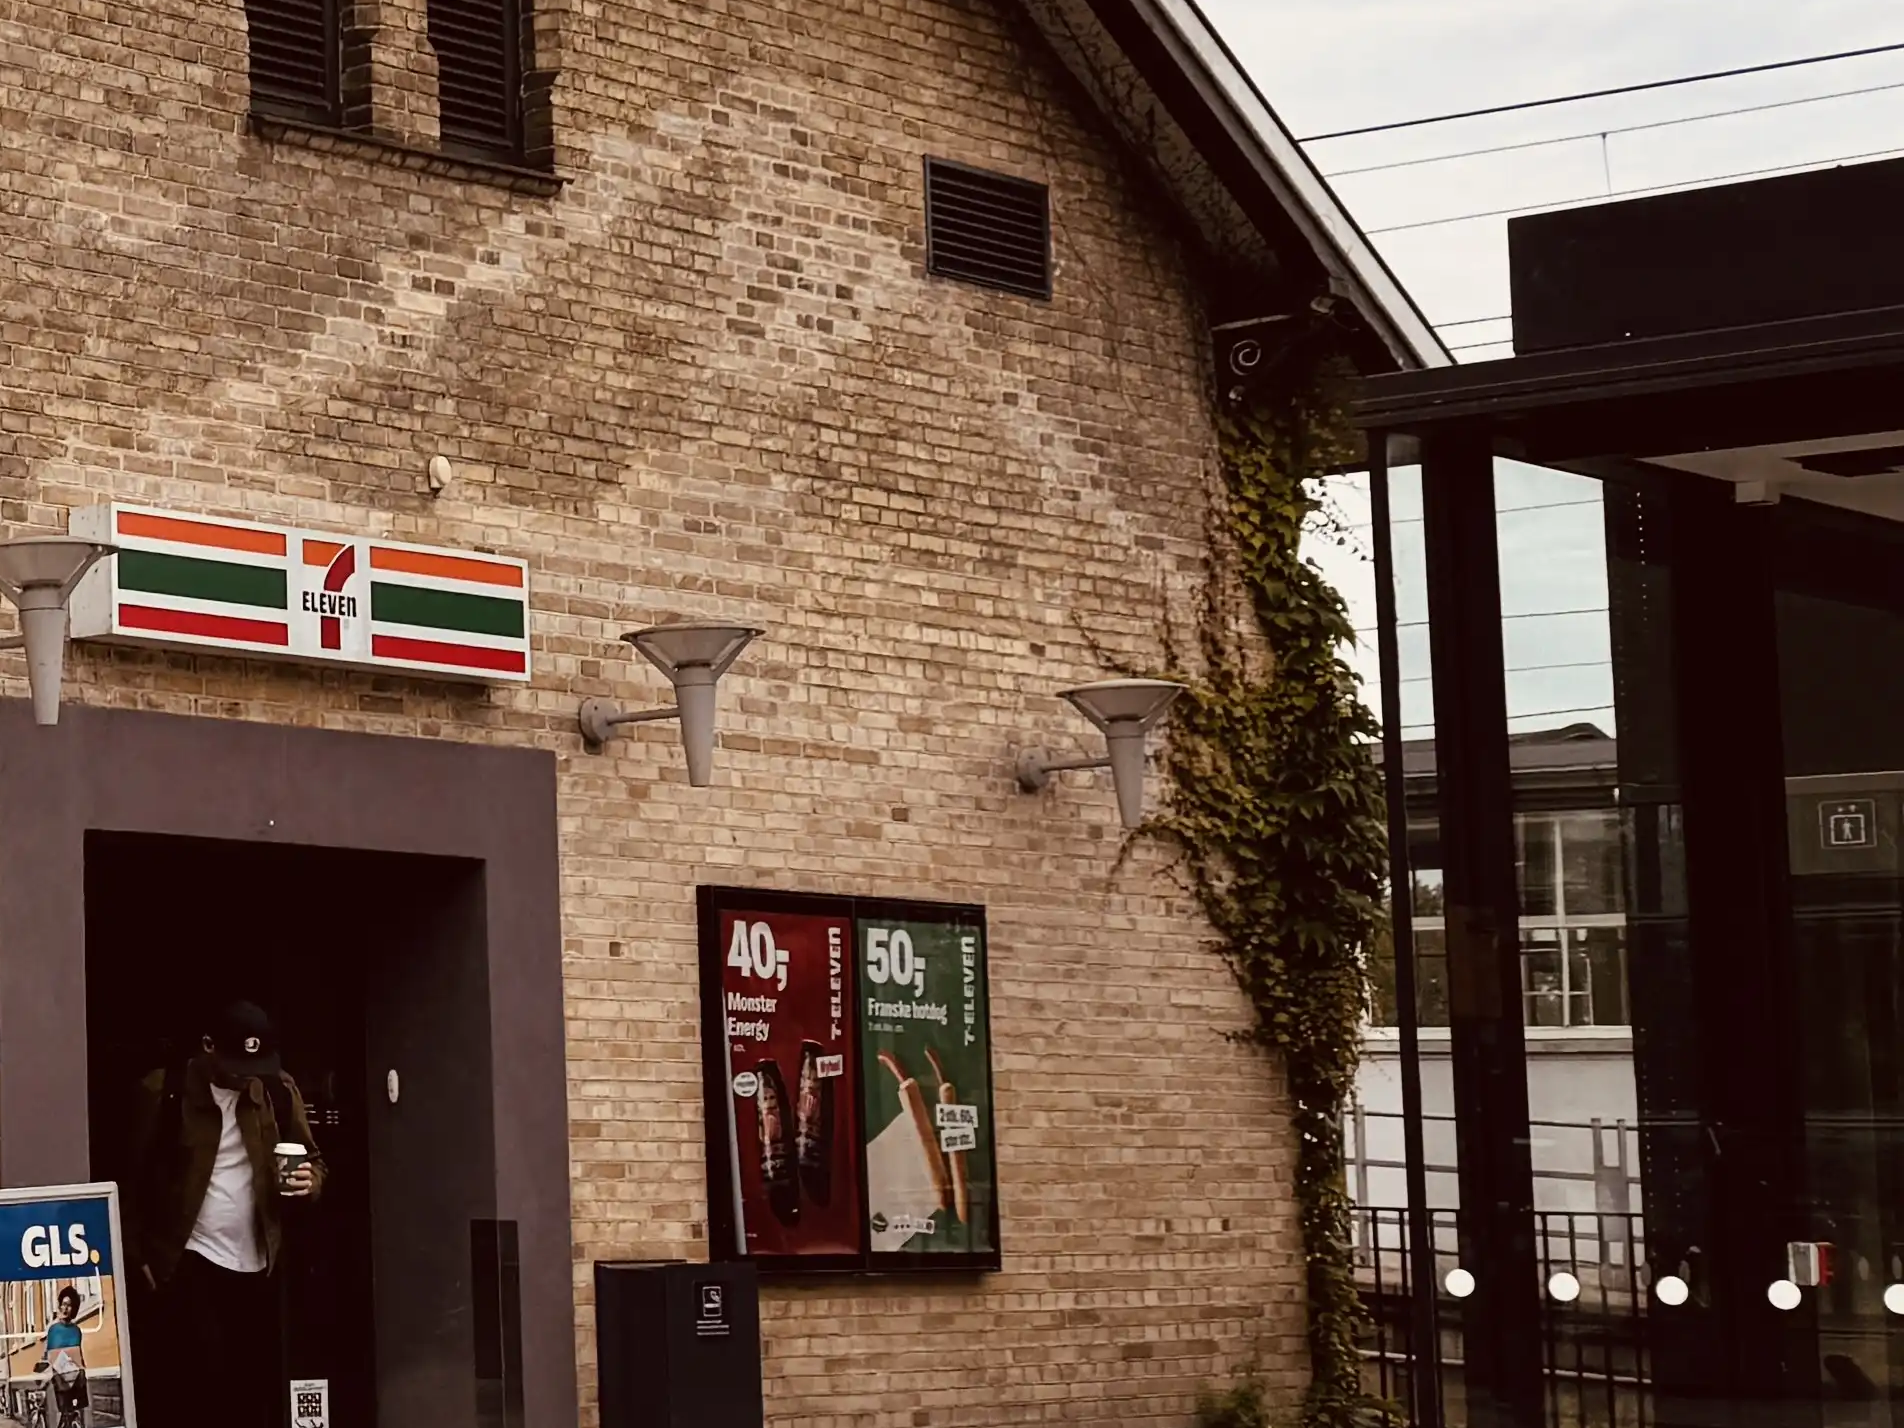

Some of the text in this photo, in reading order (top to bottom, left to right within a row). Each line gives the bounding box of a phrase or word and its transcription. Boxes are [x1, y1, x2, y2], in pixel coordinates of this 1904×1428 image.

[302, 538, 356, 650] 7
[727, 991, 778, 1013] Monster
[727, 1017, 770, 1042] Energy
